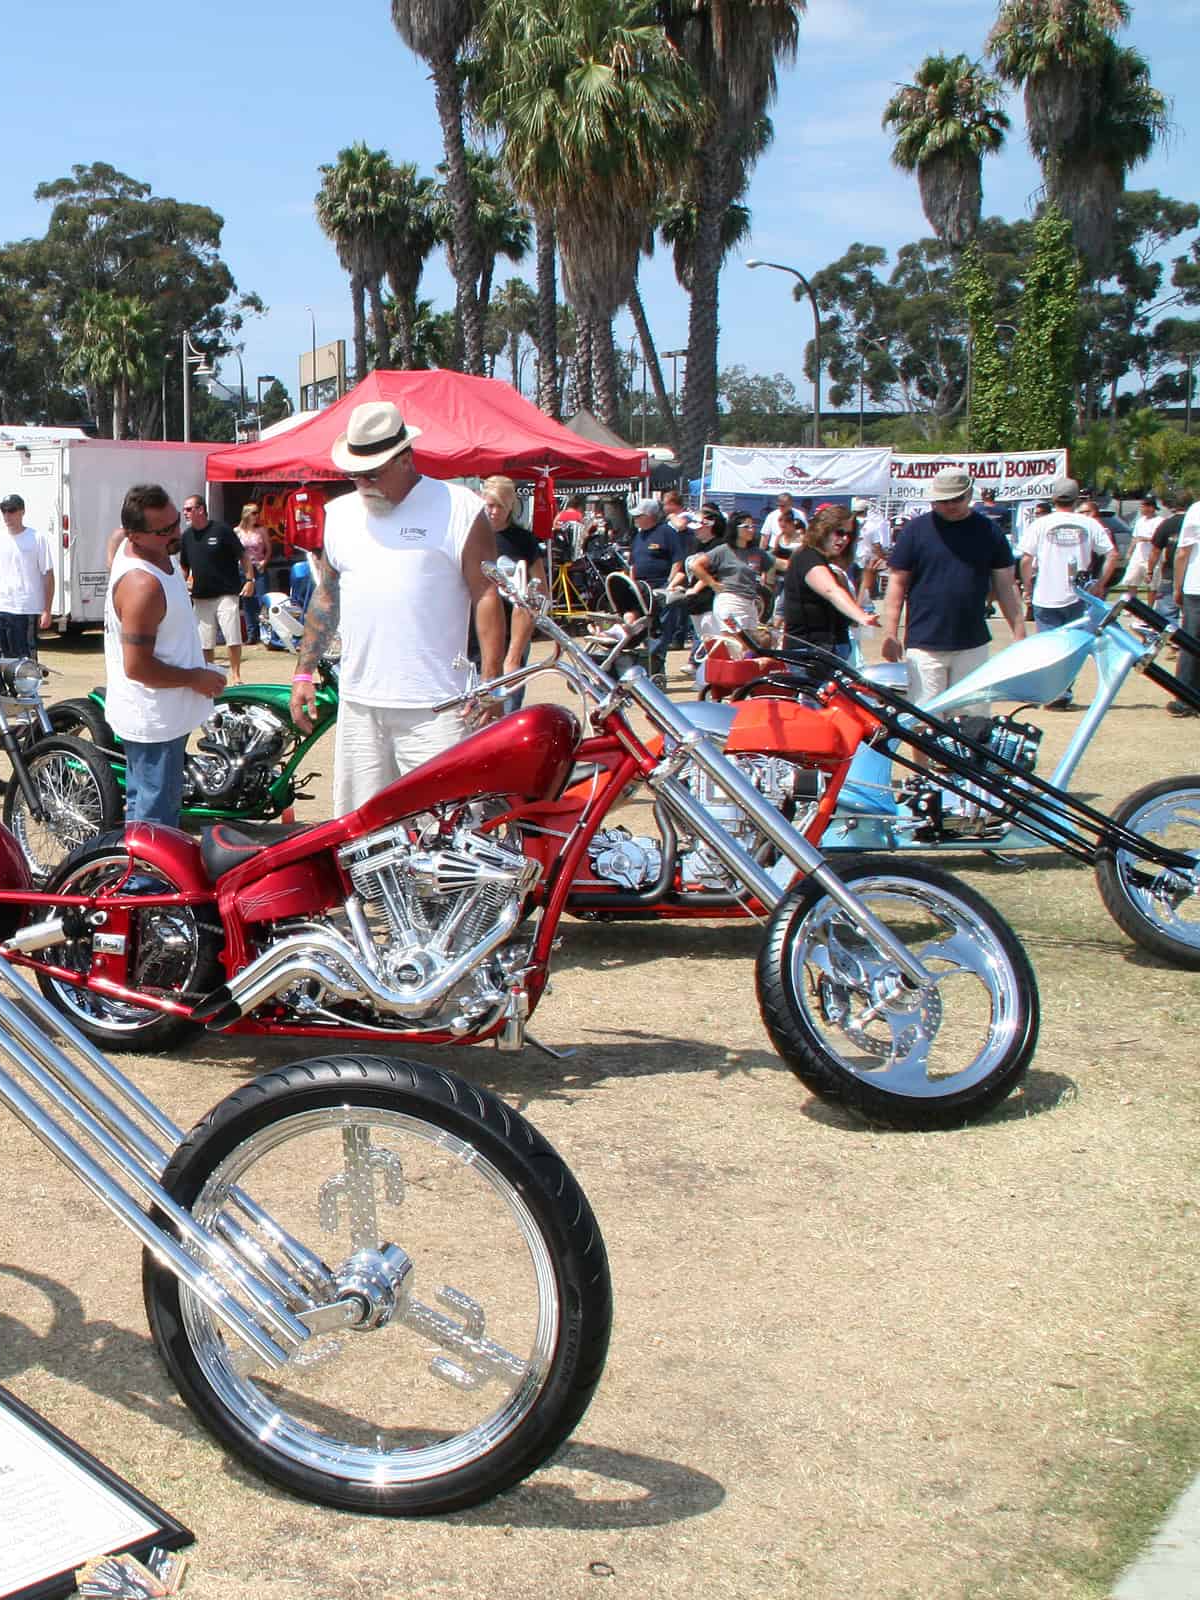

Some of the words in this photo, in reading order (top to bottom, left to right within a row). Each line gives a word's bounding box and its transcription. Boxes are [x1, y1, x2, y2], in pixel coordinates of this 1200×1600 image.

[889, 462, 964, 479] PLATIN
[968, 462, 1001, 478] BAIL
[1005, 458, 1056, 477] BONDS
